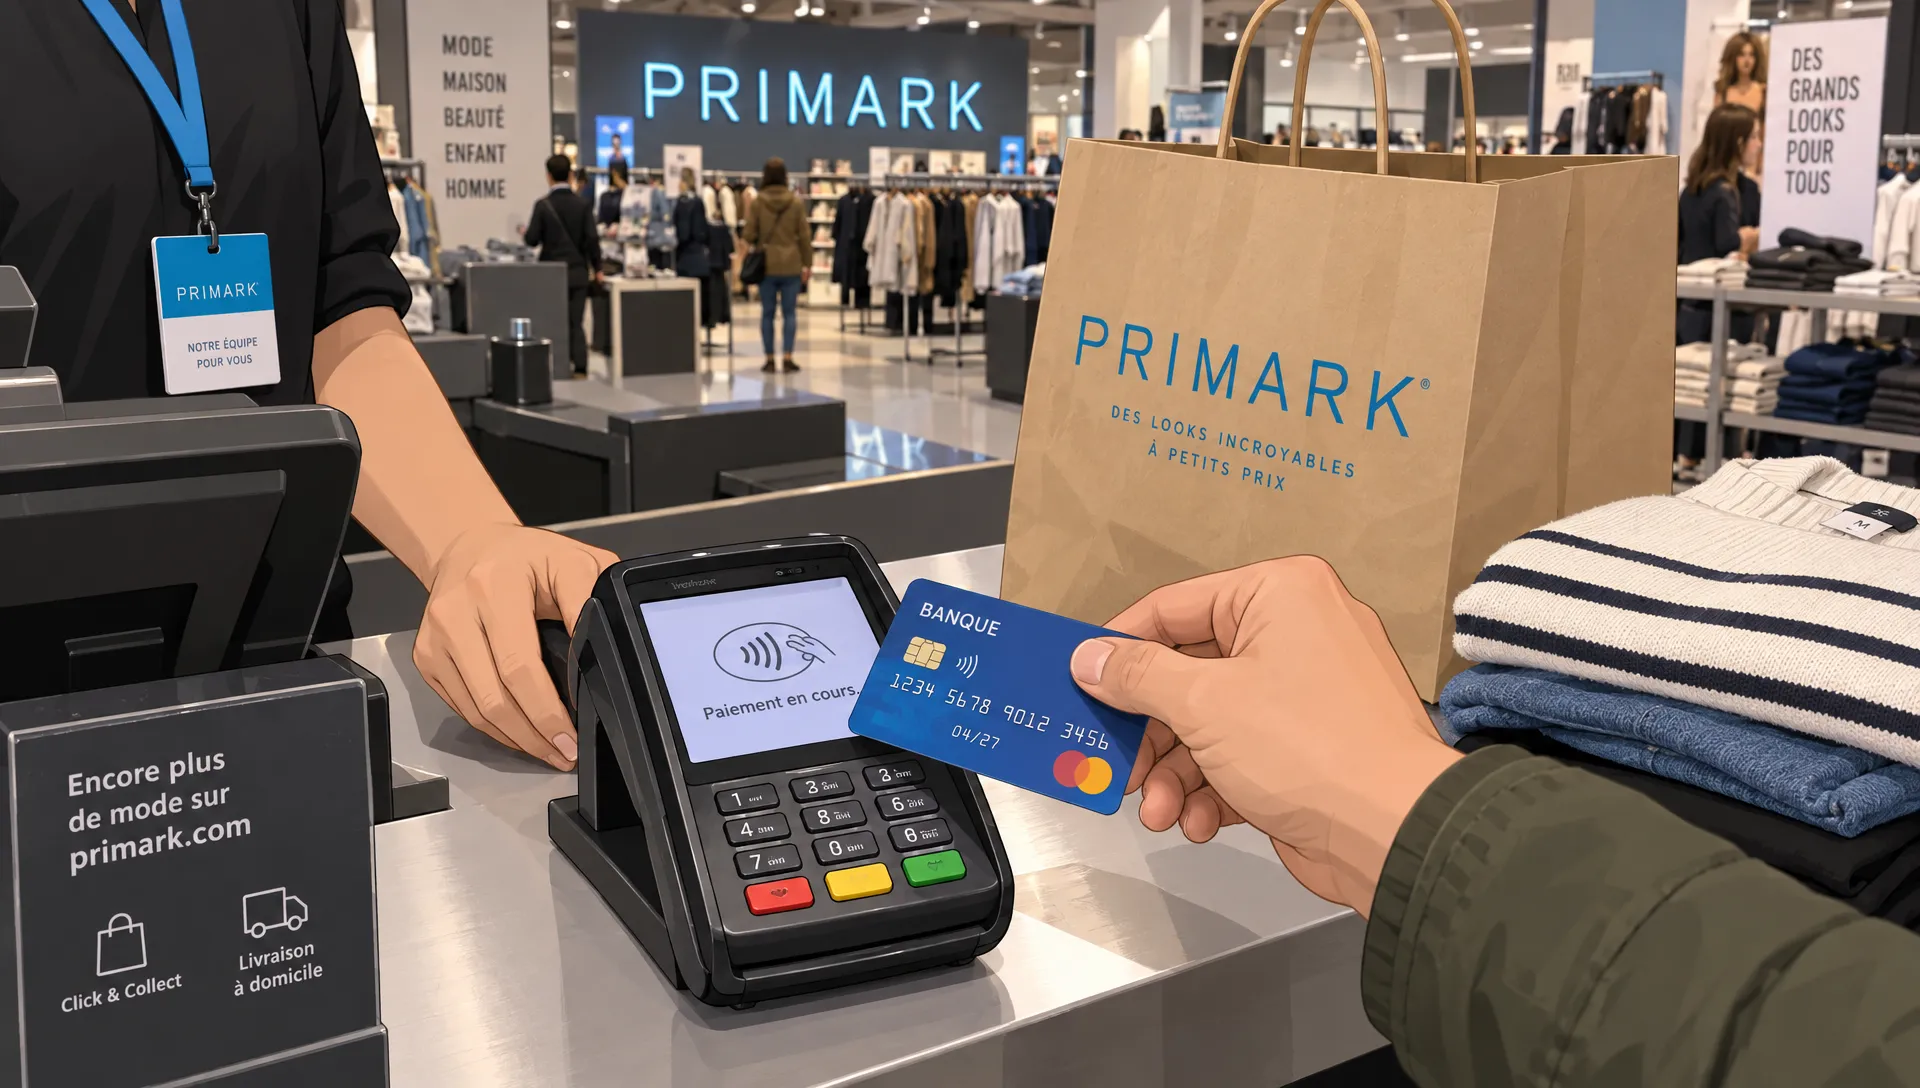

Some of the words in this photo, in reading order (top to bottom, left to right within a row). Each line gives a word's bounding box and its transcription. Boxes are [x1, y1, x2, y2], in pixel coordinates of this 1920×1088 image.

[442, 34, 493, 57] MODE
[1791, 47, 1823, 72] DES
[443, 71, 507, 93] MAISON
[1789, 75, 1860, 102] GRANDS
[643, 61, 984, 132] PRIMARK
[444, 105, 505, 129] BEAUTÉ
[1788, 107, 1845, 133] LOOKS
[445, 143, 506, 163] ENFANT
[1786, 139, 1834, 164] POUR
[446, 178, 506, 199] HOMME
[1785, 170, 1831, 195] TOUS
[187, 340, 220, 353] NOTRE
[223, 336, 258, 350] ÉQUIPE
[197, 357, 224, 369] POUR
[227, 354, 253, 366] VOUS
[1111, 405, 1141, 425] DES
[1151, 415, 1207, 441] LOOKS
[1218, 431, 1355, 479] INCROYABLES
[1147, 438, 1158, 458] À
[1168, 447, 1230, 477] PETITS
[1242, 467, 1286, 492] PRIX
[919, 602, 1002, 638] BANQUE
[703, 695, 783, 721] Paiement
[787, 693, 808, 707] en
[889, 673, 936, 698] 1234
[944, 688, 992, 715] 5678
[1003, 705, 1051, 733] 9012
[1060, 722, 1110, 751] 3456
[951, 724, 1001, 750] 04/27
[68, 764, 161, 797] Encore
[169, 751, 226, 785] plus
[68, 807, 101, 833] de
[110, 793, 183, 825] mode
[190, 785, 231, 810] sur
[731, 792, 742, 807] 1
[891, 797, 905, 811] 6
[740, 822, 754, 837] 4
[817, 809, 831, 825] 8
[70, 816, 252, 877] primark.com
[749, 854, 761, 870] 7
[239, 942, 315, 971] Livraison
[234, 980, 245, 997] à
[249, 963, 323, 993] domicile
[61, 992, 103, 1013] Click
[107, 987, 120, 1003] &
[124, 973, 183, 999] Collect
